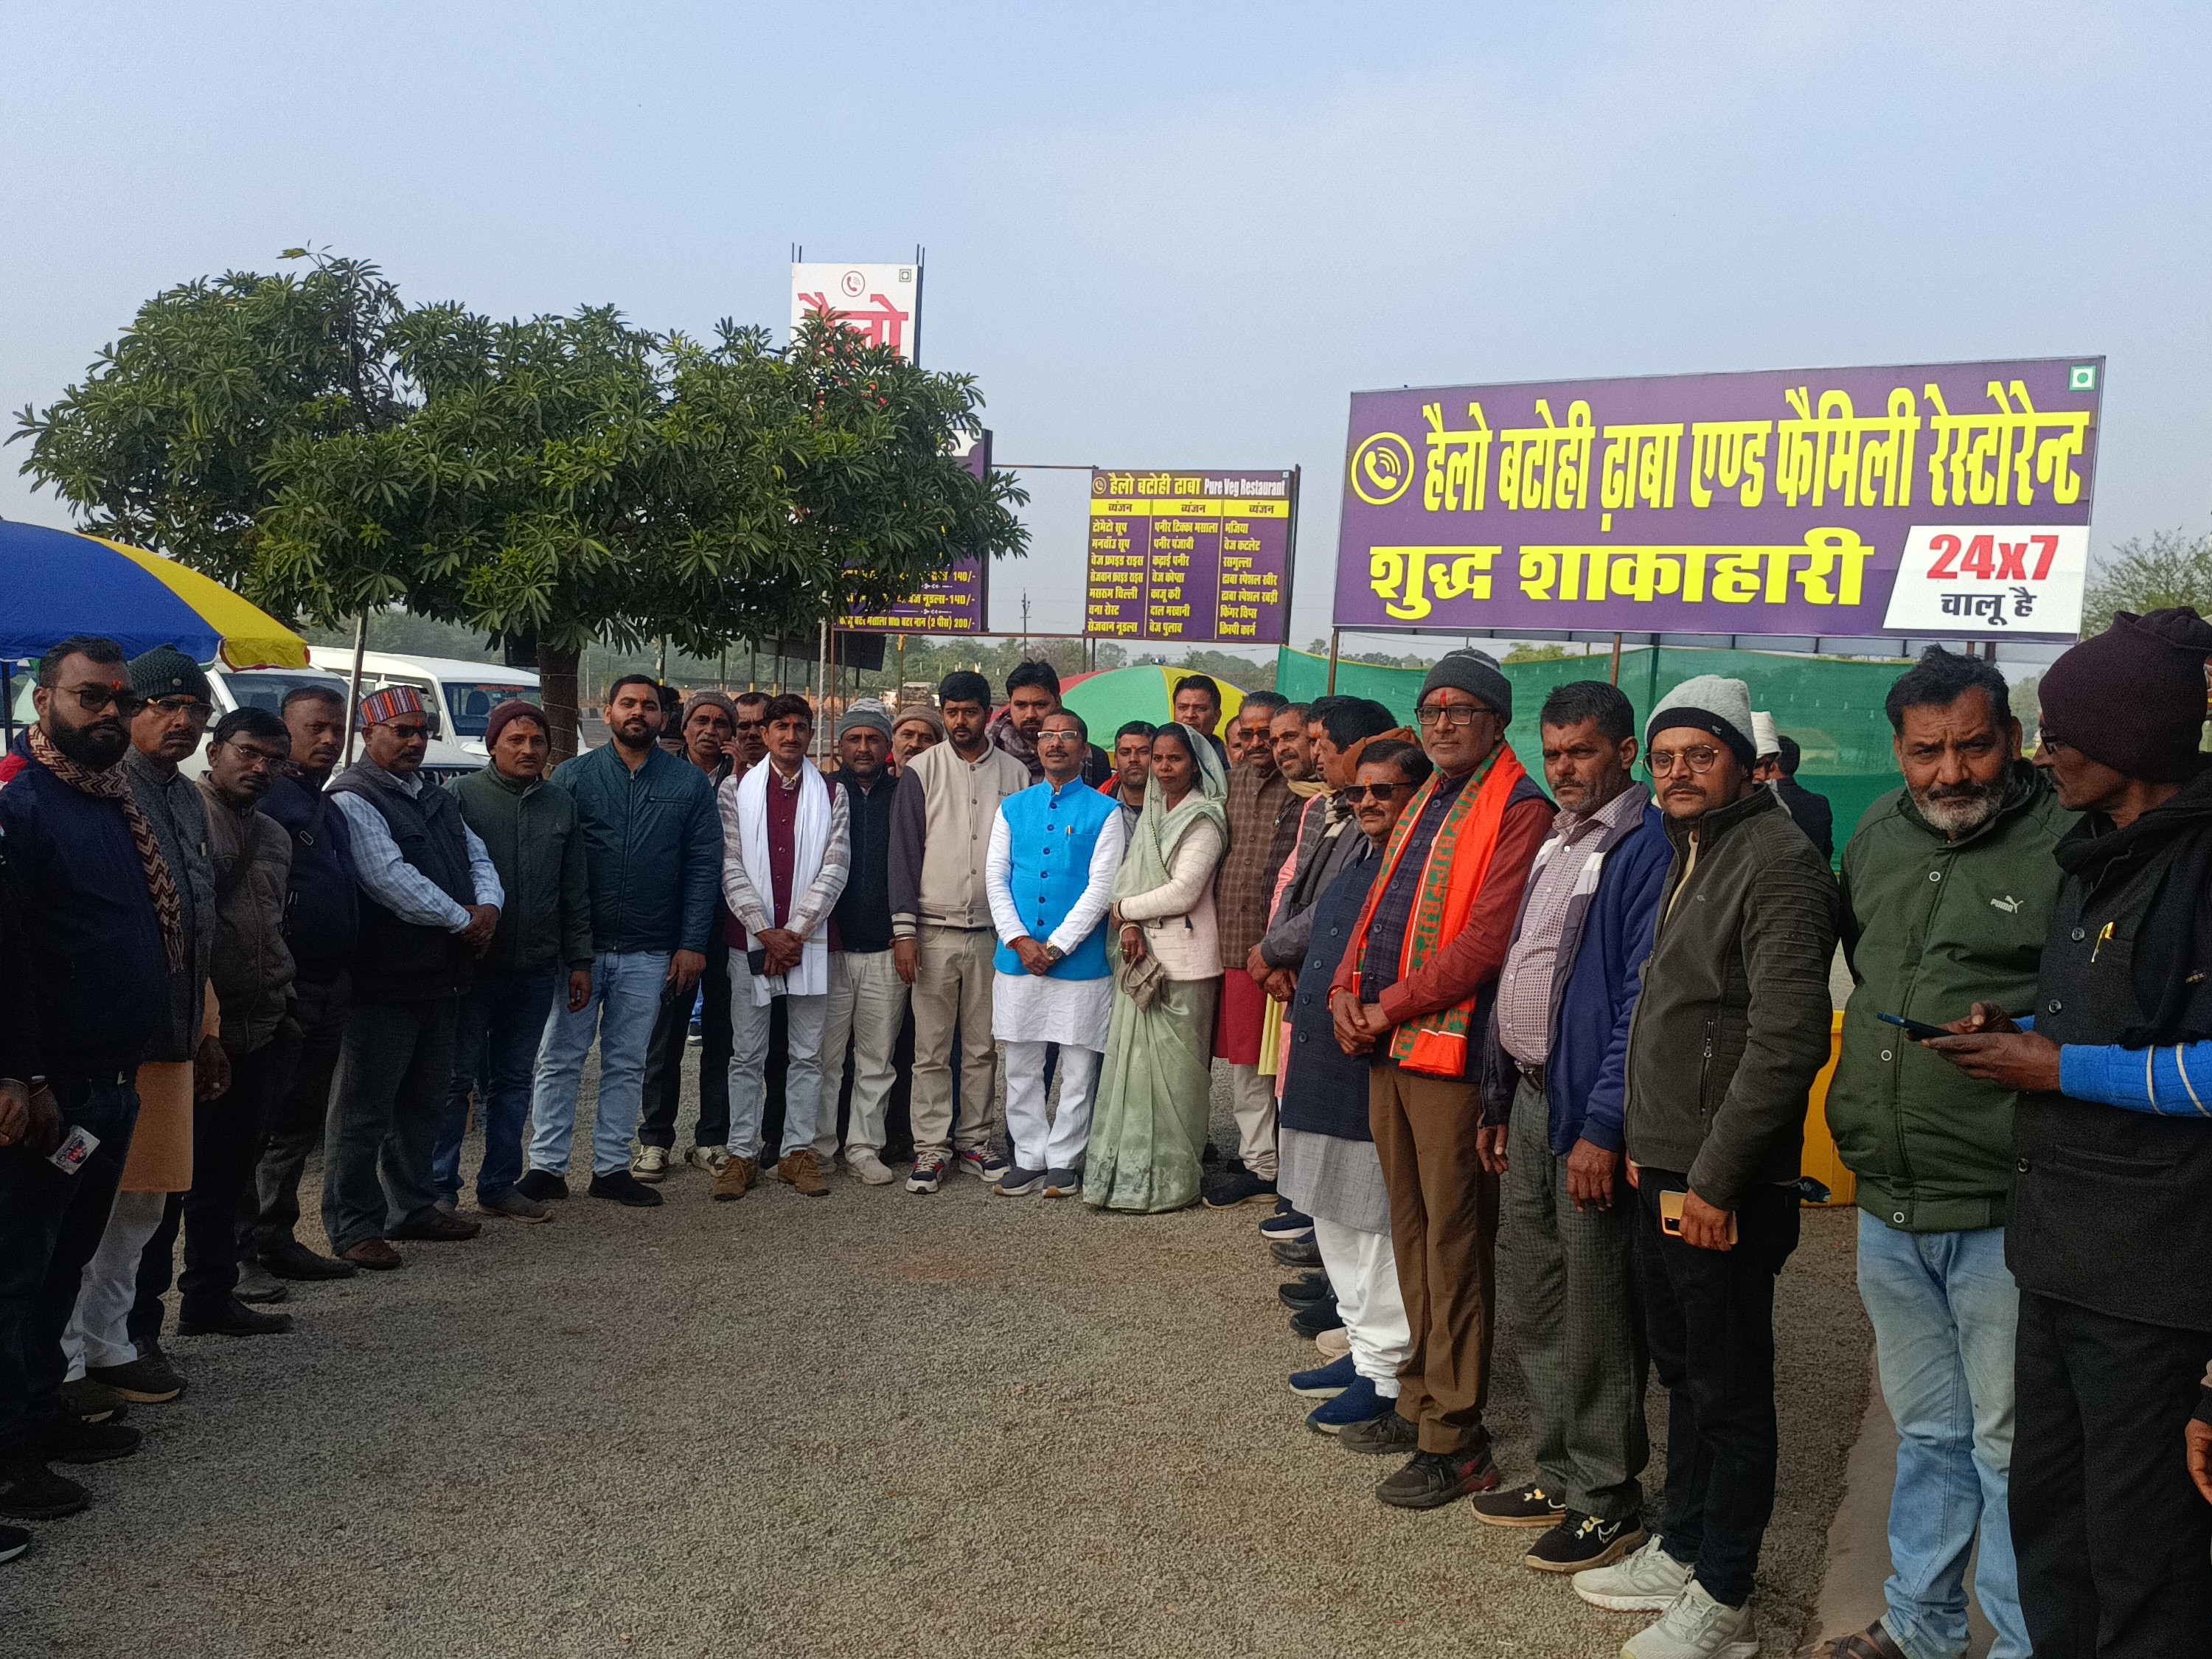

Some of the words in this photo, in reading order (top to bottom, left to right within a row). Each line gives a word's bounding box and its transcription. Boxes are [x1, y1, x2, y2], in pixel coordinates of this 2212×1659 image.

[1422, 403, 1493, 511] हैलो
[1498, 399, 1596, 510] बटोही
[1690, 420, 1773, 508] एण्ड
[1775, 386, 1921, 507] फैमिली
[1924, 380, 2090, 507] रेस्टोरेन्ट
[1108, 472, 1135, 495] हैलो
[1136, 472, 1172, 495] बटोही
[1174, 477, 1202, 495] ढाबा
[1203, 478, 1223, 495] Pure
[1224, 478, 1239, 498] Veg
[1239, 479, 1286, 496] Restaurant
[1108, 501, 1133, 512] व्यंजन
[1181, 501, 1206, 513] व्यंजन
[1249, 501, 1275, 514] व्यंजन
[1154, 518, 1172, 533] पनीर
[1194, 522, 1219, 533] मसाला
[1153, 535, 1171, 549] पनीर
[1926, 534, 2059, 580] 24x7
[1369, 545, 1502, 620] शुद्ध
[1519, 526, 1875, 605] शाकाहारी
[1941, 594, 2008, 626] चालू
[2008, 587, 2037, 617] है
[953, 617, 975, 630] 200/-
[1990, 898, 2014, 913] PUMA
[1417, 900, 1441, 947] BJP
